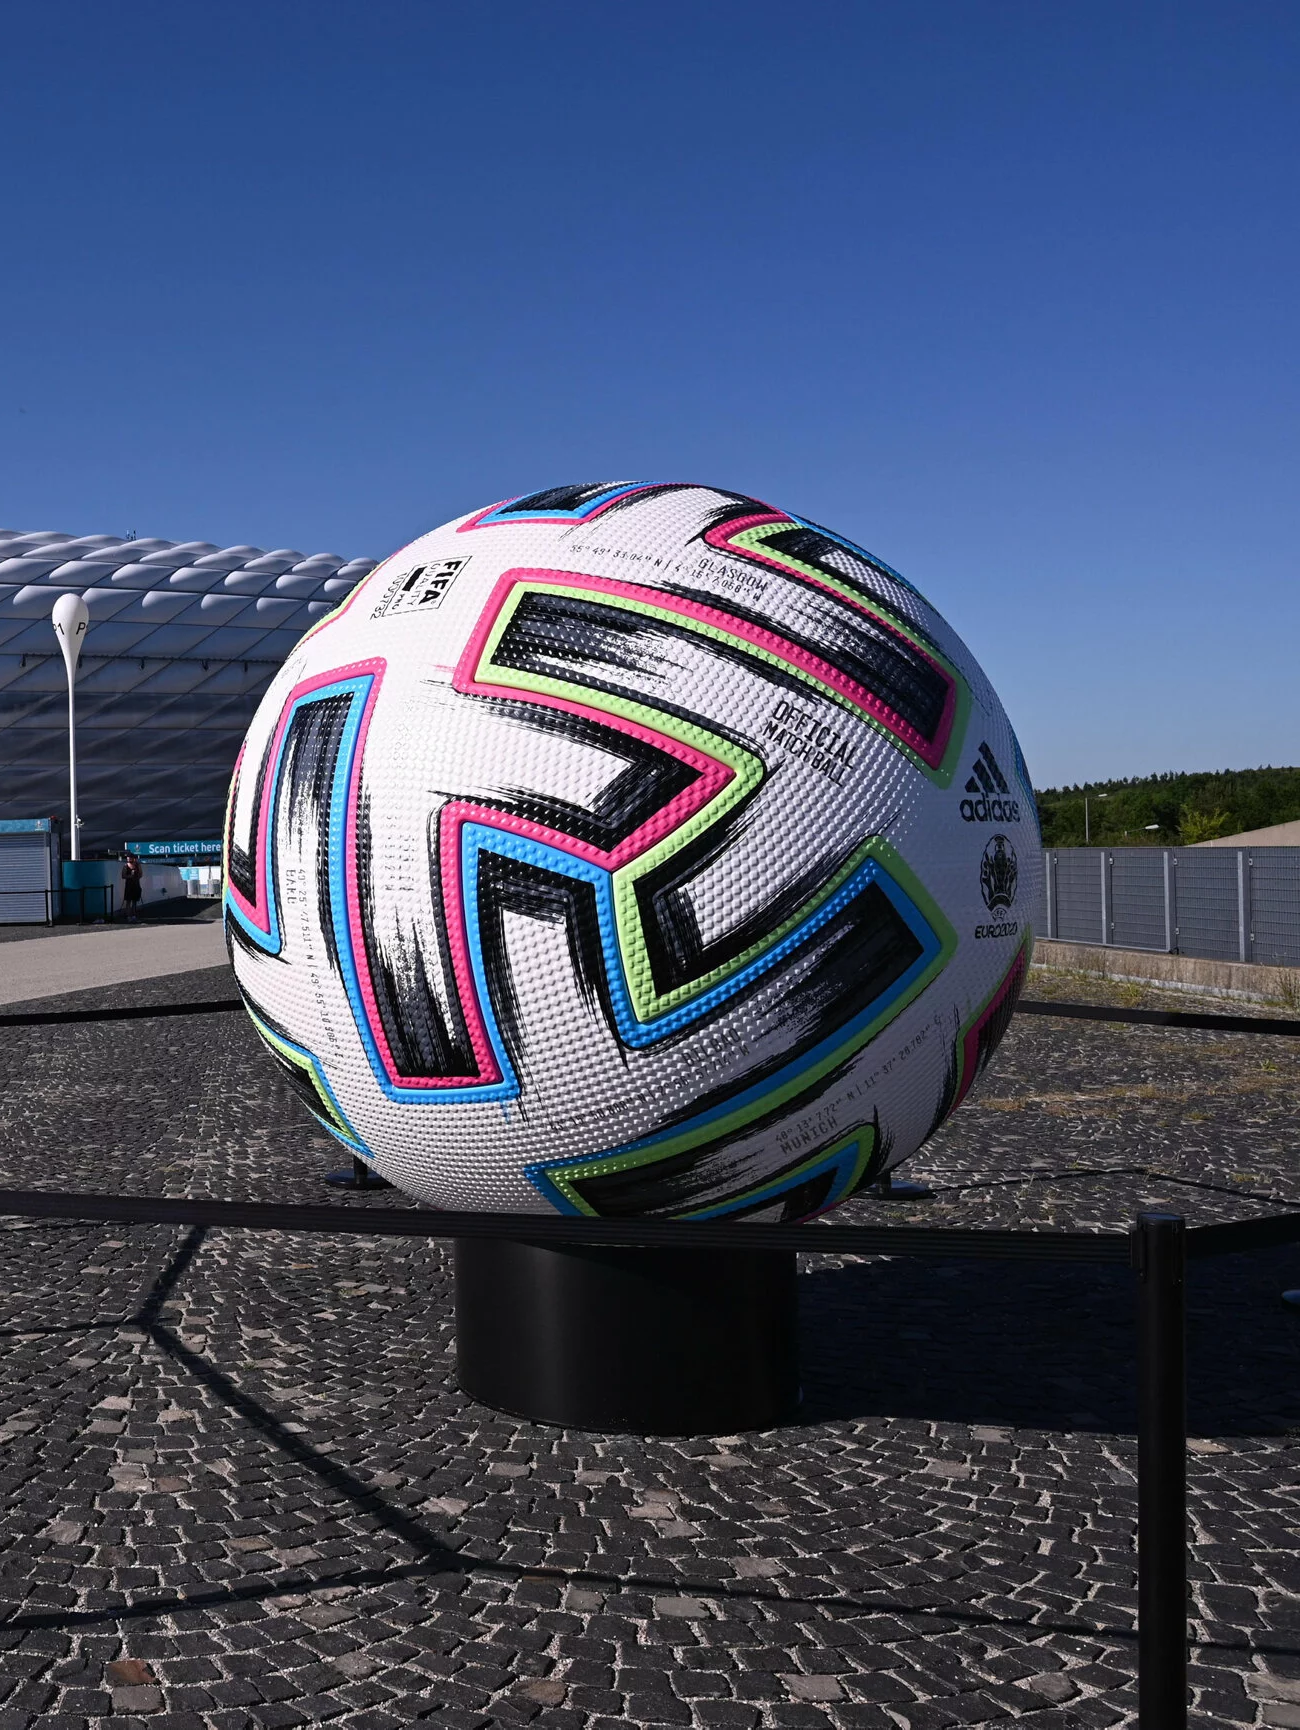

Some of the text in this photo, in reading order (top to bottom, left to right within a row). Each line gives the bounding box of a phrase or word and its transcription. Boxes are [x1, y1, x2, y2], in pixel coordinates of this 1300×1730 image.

[418, 560, 463, 605] FIFA
[653, 558, 663, 567] N
[698, 558, 768, 592] GLASGOW
[407, 563, 441, 606] QUALITY
[762, 720, 846, 788] MATCH BALL
[772, 700, 856, 770] OFFICIAL
[959, 792, 1021, 823] adidas
[148, 842, 221, 854] Scan ticket here
[974, 922, 1018, 939] EURO2020
[681, 1027, 741, 1067] BILBAO
[779, 1115, 838, 1155] MUNICH
